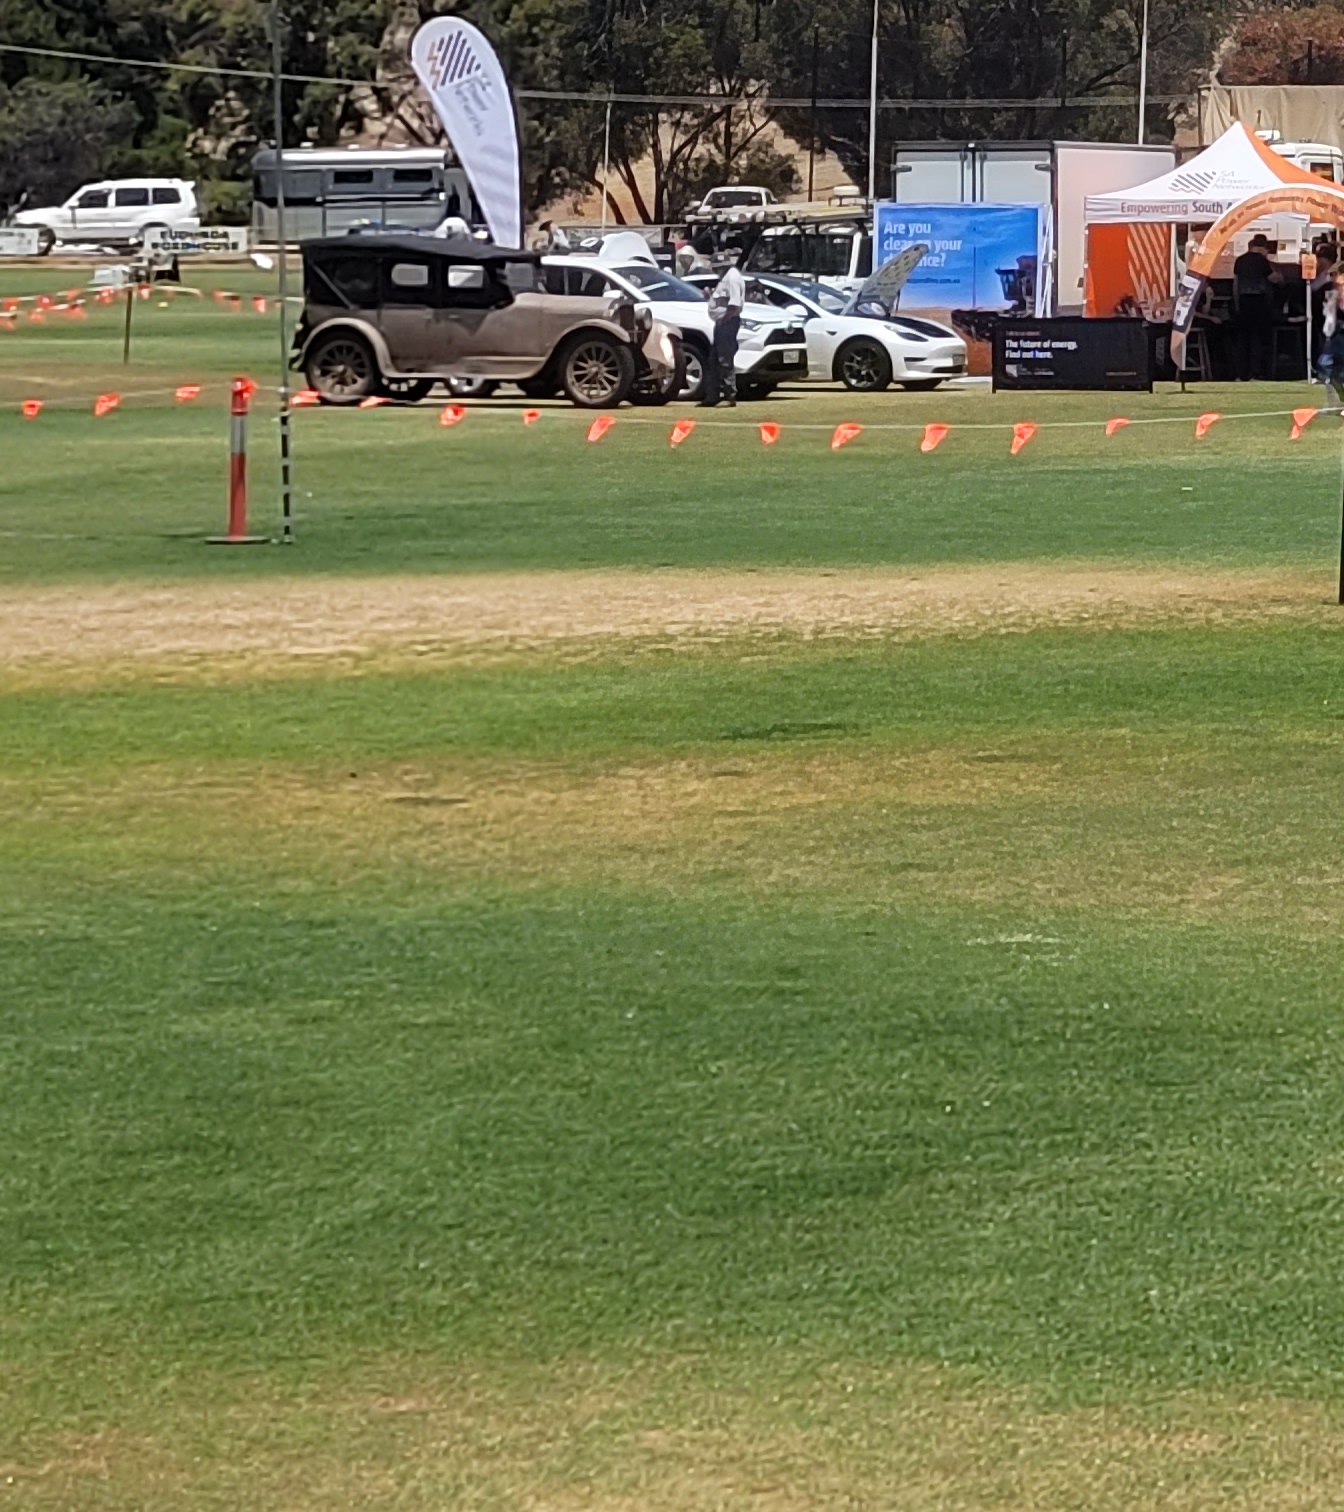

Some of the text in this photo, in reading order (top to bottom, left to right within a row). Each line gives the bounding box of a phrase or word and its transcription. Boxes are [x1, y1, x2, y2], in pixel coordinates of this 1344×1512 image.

[1120, 201, 1189, 215] Empowering
[1192, 200, 1223, 215] South
[883, 221, 931, 237] Are you
[934, 239, 963, 254] your
[1005, 339, 1018, 348] The
[1020, 339, 1041, 348] future
[1043, 339, 1050, 348] of
[1005, 350, 1020, 358] Find
[1035, 350, 1053, 359] here.
